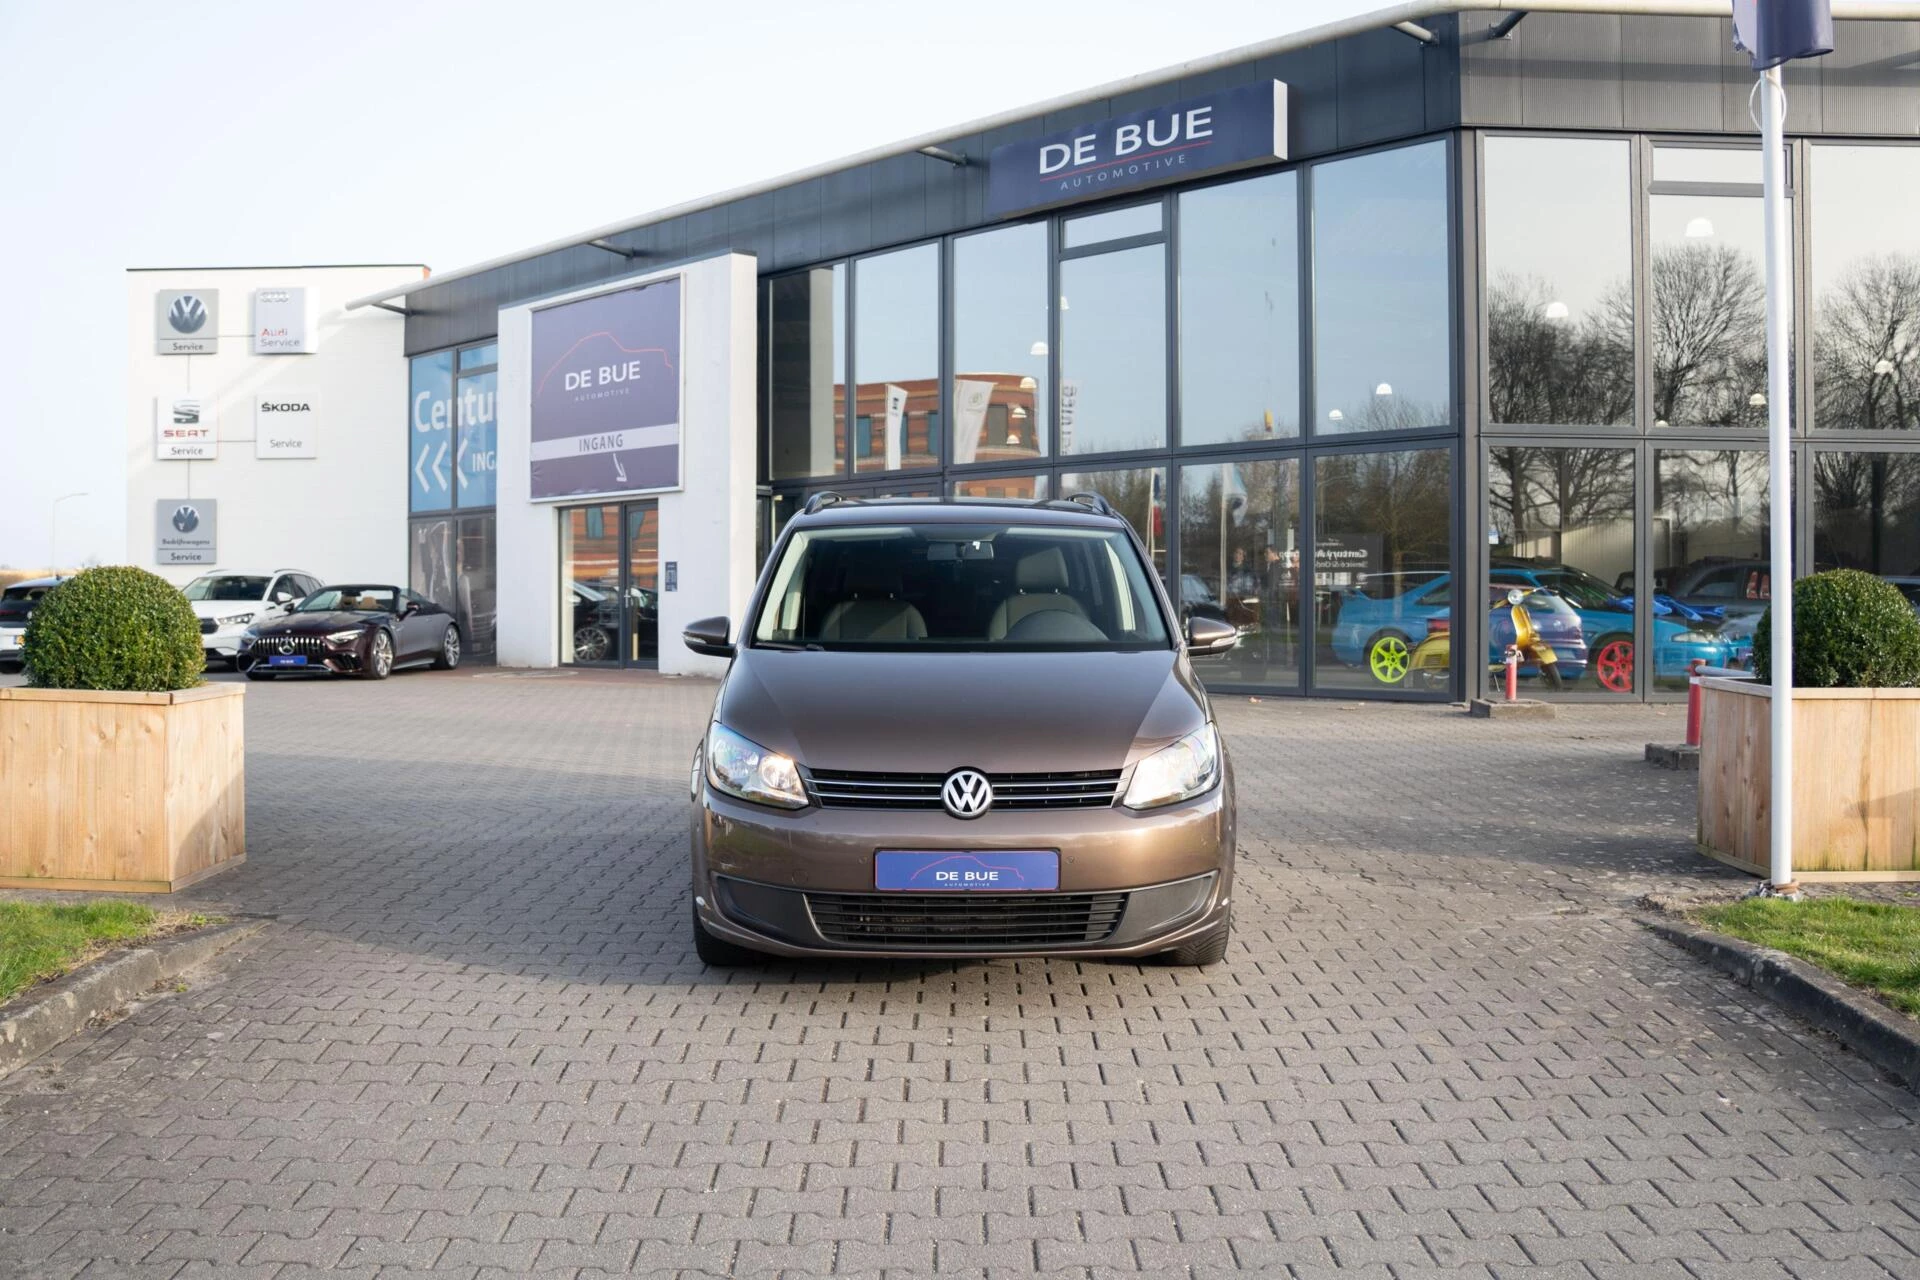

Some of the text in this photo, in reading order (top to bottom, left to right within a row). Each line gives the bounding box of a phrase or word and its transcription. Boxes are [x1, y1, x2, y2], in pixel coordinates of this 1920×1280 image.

[1039, 105, 1213, 175] DE BUE
[1060, 154, 1186, 191] AUTOMOTIVE
[261, 328, 288, 337] Audi
[172, 342, 204, 351] Service
[260, 338, 300, 348] Service
[564, 360, 641, 391] DE BUE
[575, 387, 630, 402] AUTOMOTIVE
[261, 401, 311, 412] ŠKODA
[163, 429, 209, 438] SEAT
[270, 439, 303, 449] Service
[578, 433, 624, 453] INGANG
[170, 446, 204, 456] Service
[472, 451, 497, 472] ING
[170, 552, 202, 561] Service
[935, 871, 999, 881] DE BUE
